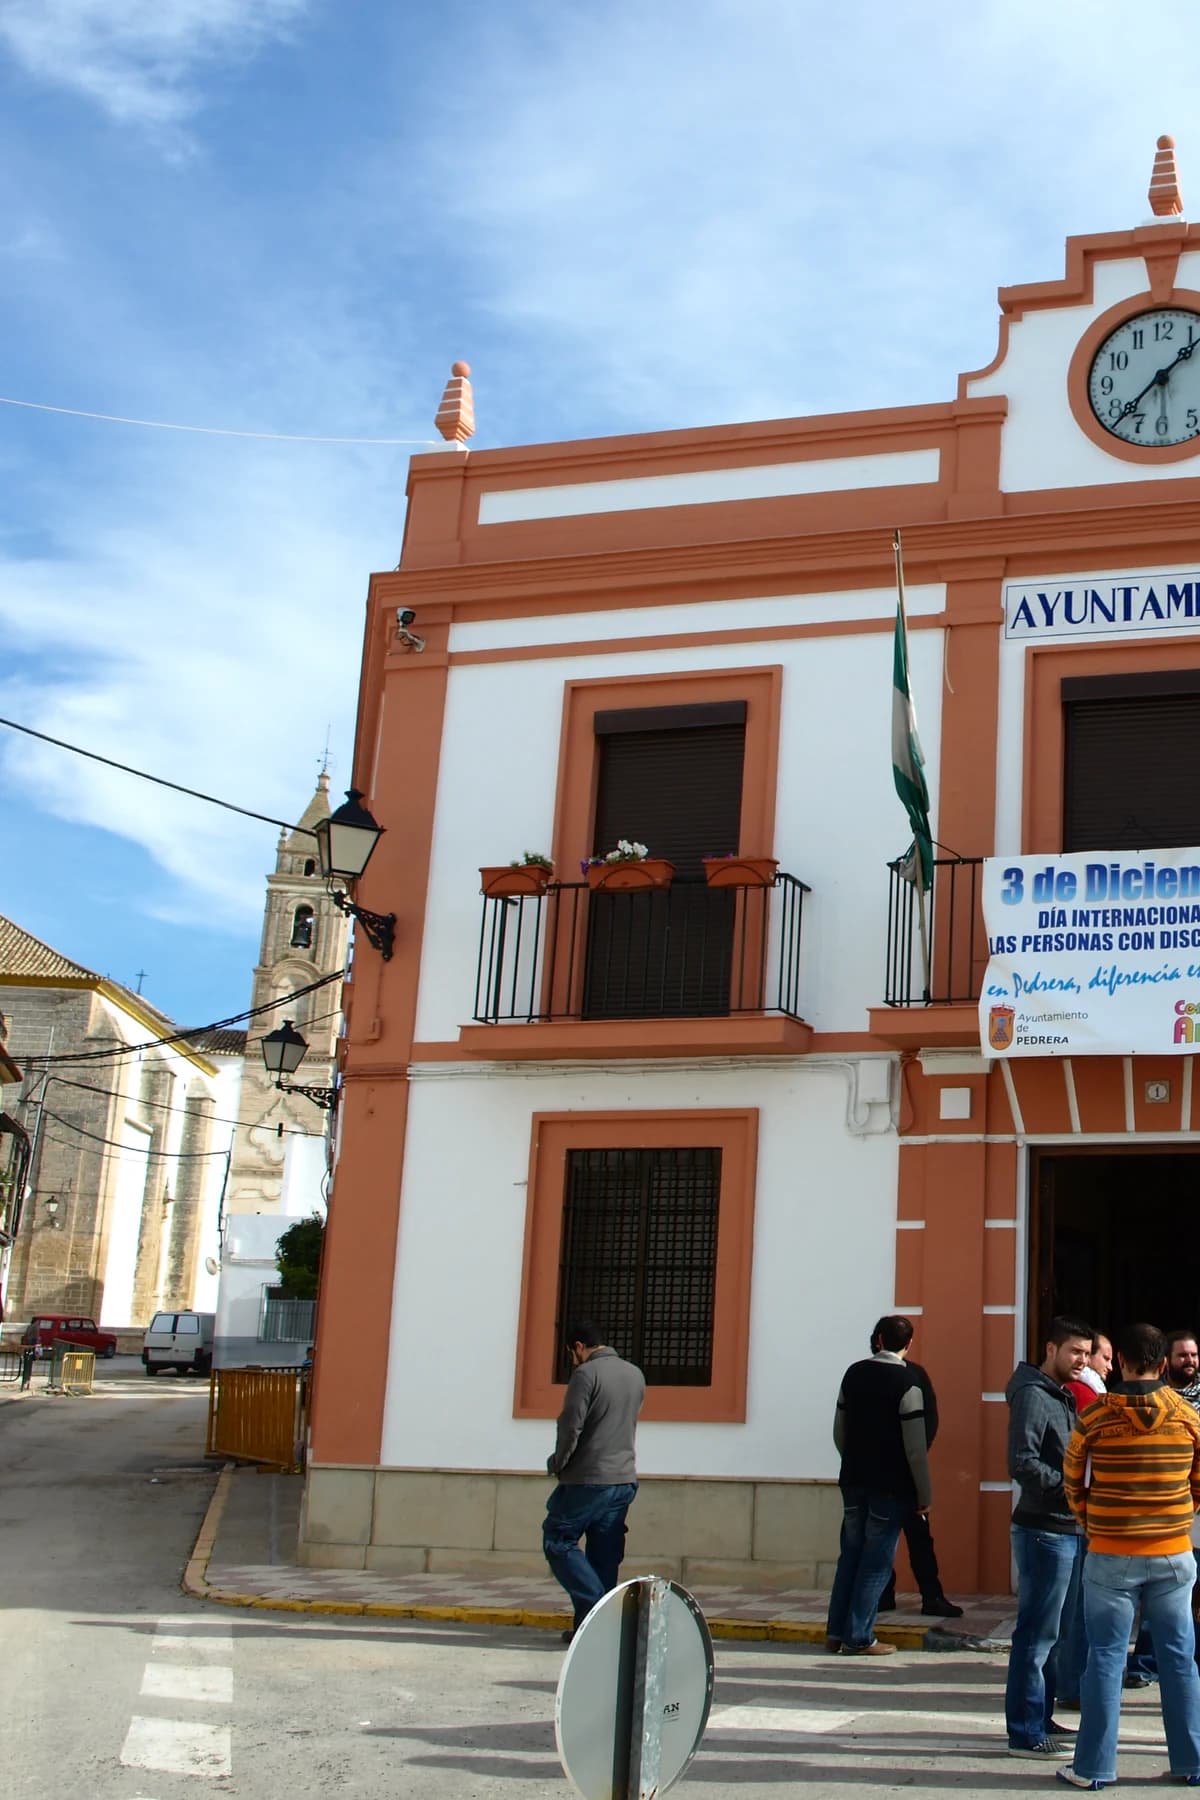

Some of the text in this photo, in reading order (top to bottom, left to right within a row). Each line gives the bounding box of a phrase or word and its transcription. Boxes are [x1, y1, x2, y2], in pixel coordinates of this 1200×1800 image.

[1132, 329, 1144, 350] 11
[1154, 321, 1174, 341] 12
[1188, 325, 1193, 346] 1
[1110, 350, 1129, 371] 10
[1101, 375, 1114, 396] 9
[1108, 398, 1122, 419] 8
[1185, 408, 1198, 429] 5
[1132, 413, 1147, 434] 7
[1155, 415, 1169, 436] 6
[1001, 867, 1024, 905] 3
[1032, 866, 1077, 904] de
[1038, 905, 1067, 929] DÍA
[989, 935, 1017, 956] LAS
[1021, 931, 1113, 953] PERSONAS
[1118, 930, 1155, 951] CON
[987, 985, 1009, 996] en
[1012, 971, 1080, 998] Pedrera,
[1088, 965, 1181, 996] diferencia
[1016, 1023, 1029, 1033] de
[1017, 1011, 1089, 1024] Ayuntamiento
[1016, 1035, 1069, 1046] PEDRERA
